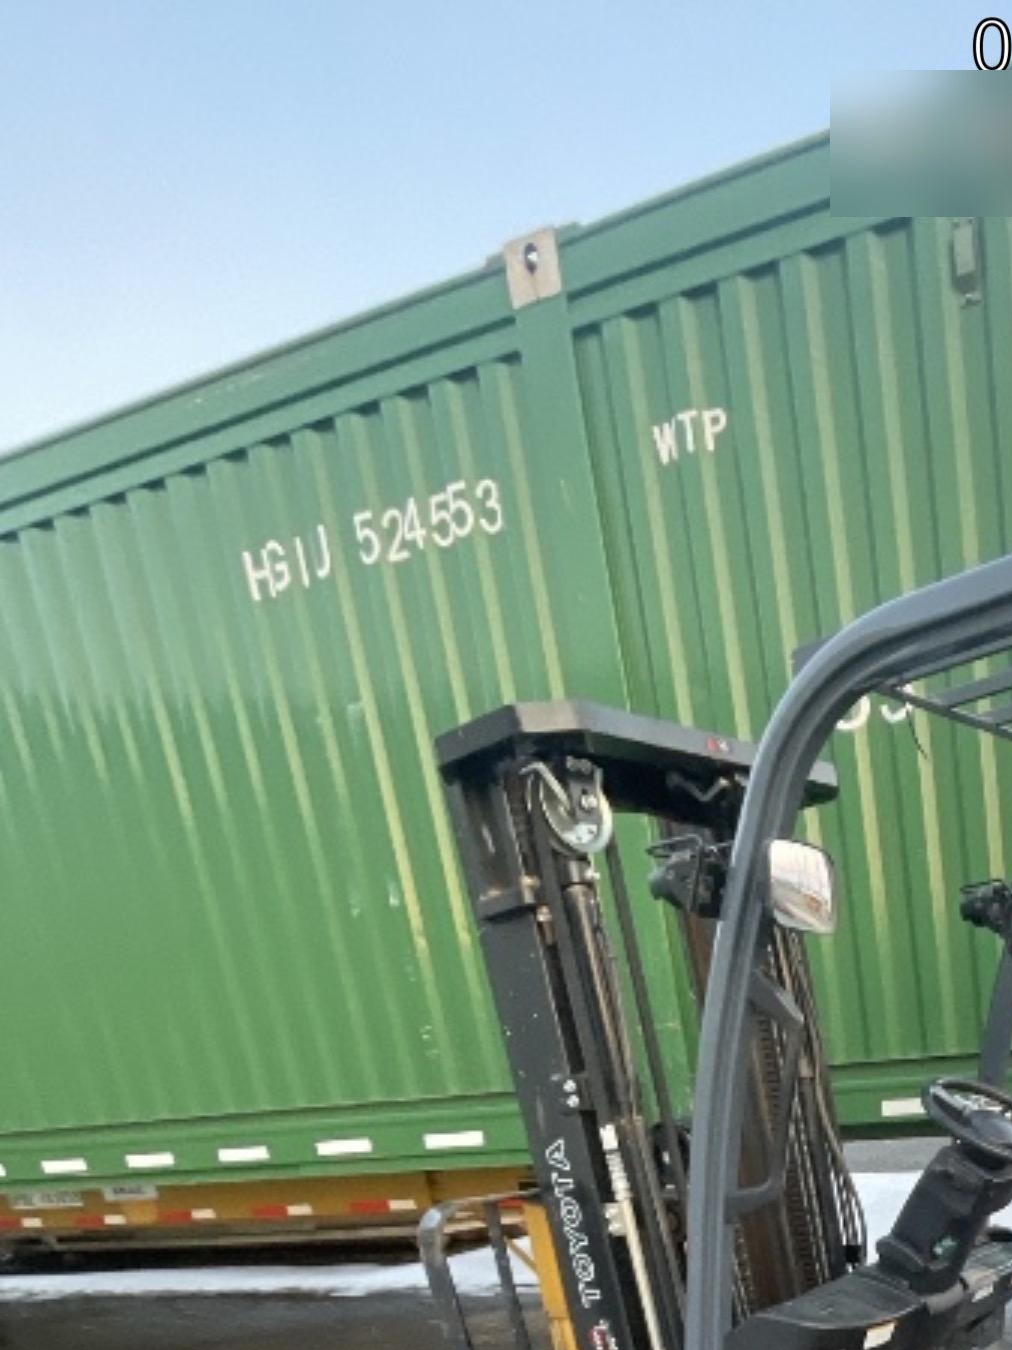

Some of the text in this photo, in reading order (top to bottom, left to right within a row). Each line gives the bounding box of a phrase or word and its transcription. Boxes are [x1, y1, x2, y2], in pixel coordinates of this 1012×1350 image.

[653, 407, 727, 465] WTP
[353, 479, 502, 565] 524553
[545, 1138, 602, 1309] TOYOTA
